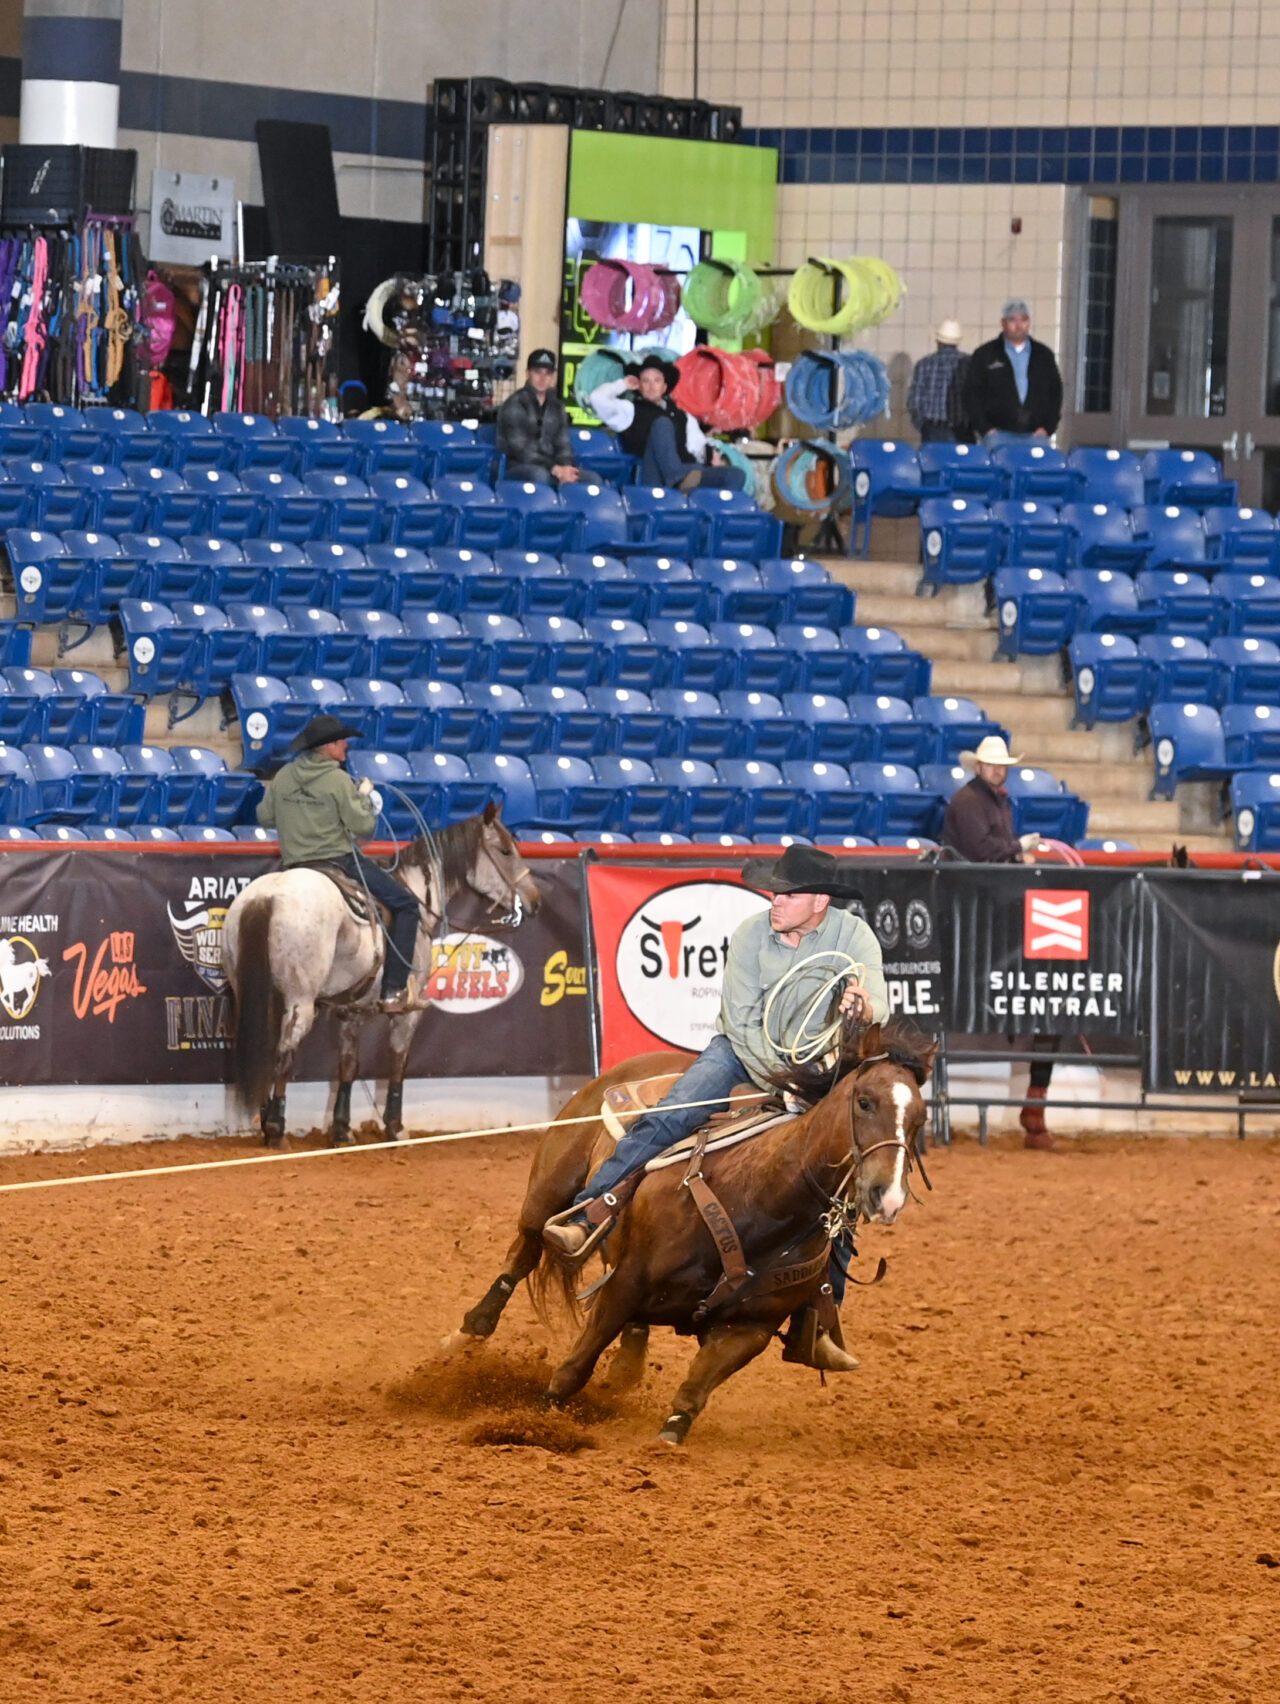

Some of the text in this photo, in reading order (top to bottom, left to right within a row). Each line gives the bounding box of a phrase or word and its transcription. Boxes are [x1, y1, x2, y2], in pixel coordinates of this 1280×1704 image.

[175, 204, 223, 227] MARTIN
[19, 914, 59, 932] HEALTH
[111, 933, 134, 962] LAS
[63, 937, 147, 1024] Vegas
[989, 971, 1123, 992] SILENCER
[887, 979, 940, 1014] PLE.
[993, 996, 1118, 1017] CENTRAL
[703, 1202, 738, 1254] CACTUS
